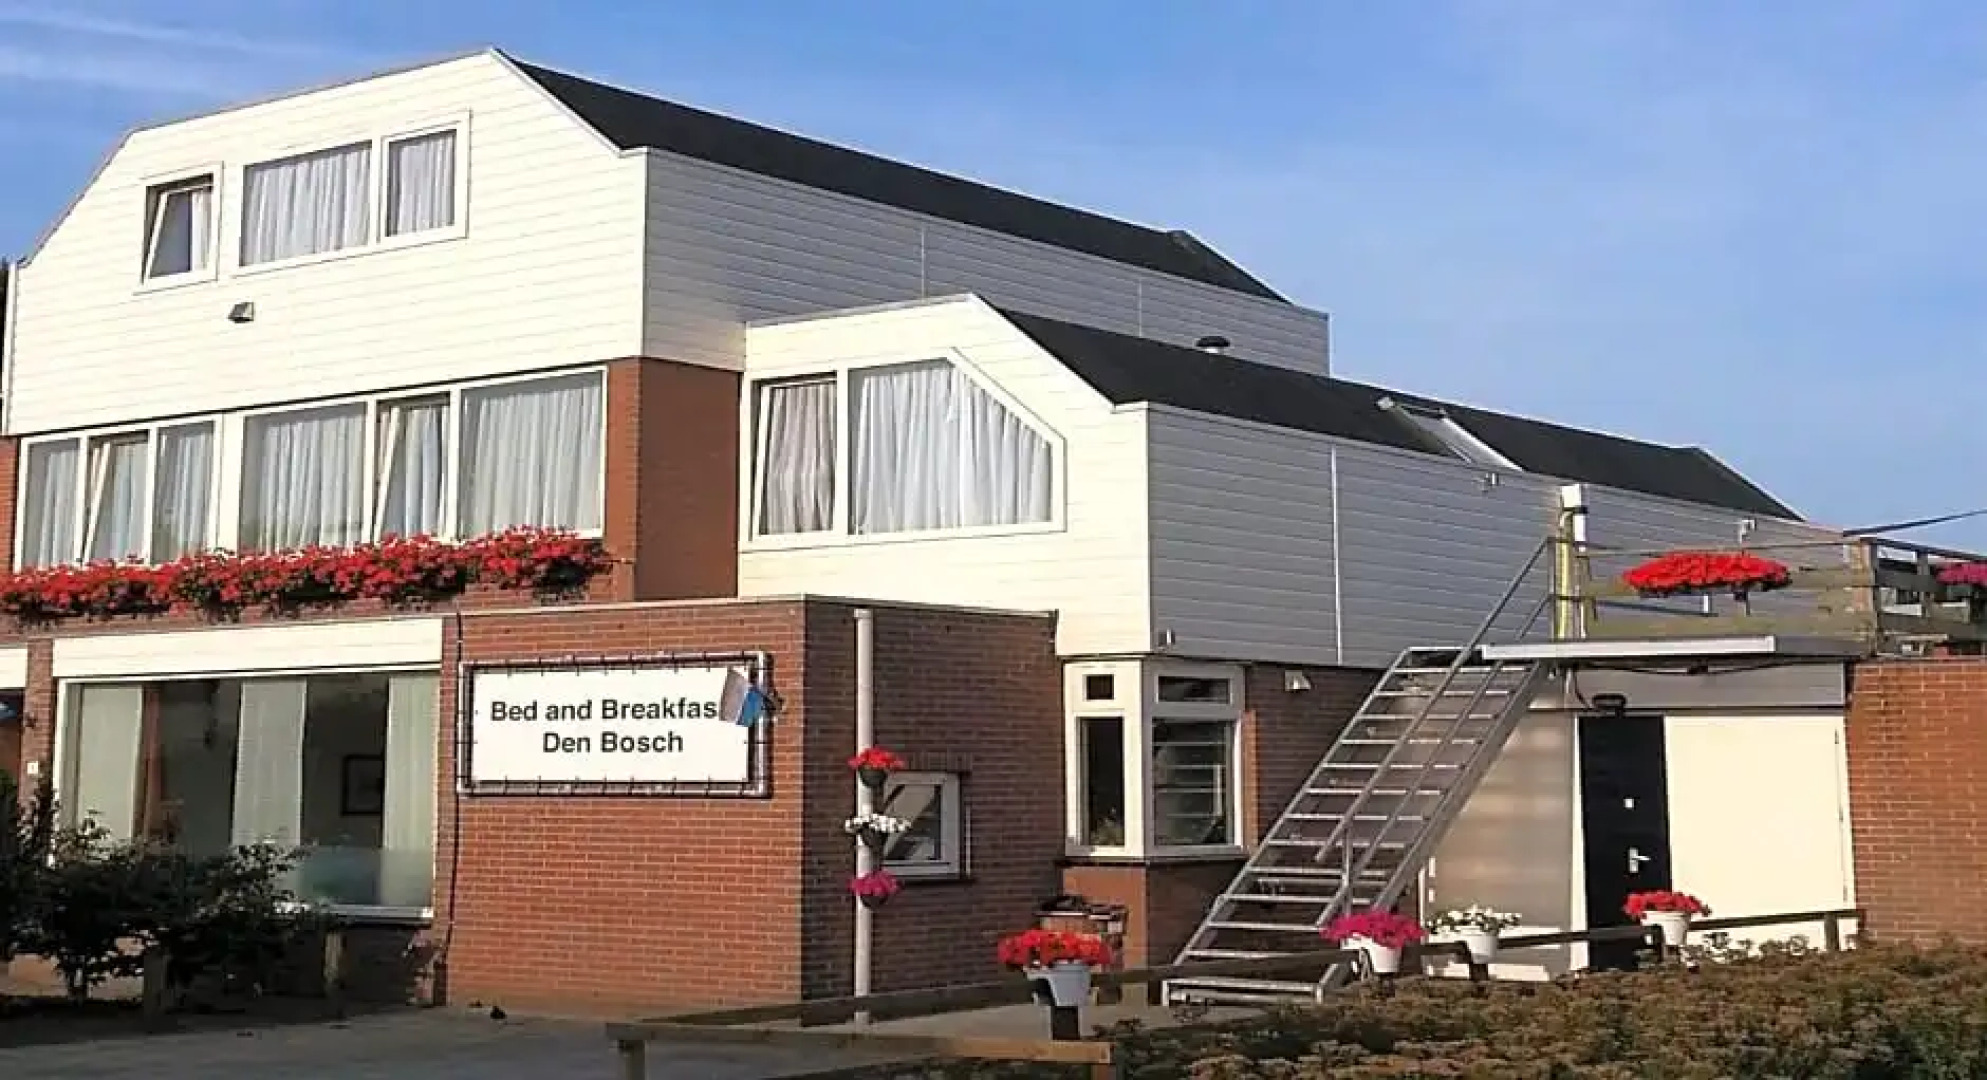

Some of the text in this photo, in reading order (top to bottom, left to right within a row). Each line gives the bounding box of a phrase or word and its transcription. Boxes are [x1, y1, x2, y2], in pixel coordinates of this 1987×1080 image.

[490, 697, 719, 722] Bed and Breakfas
[542, 730, 684, 753] Den Bosch
